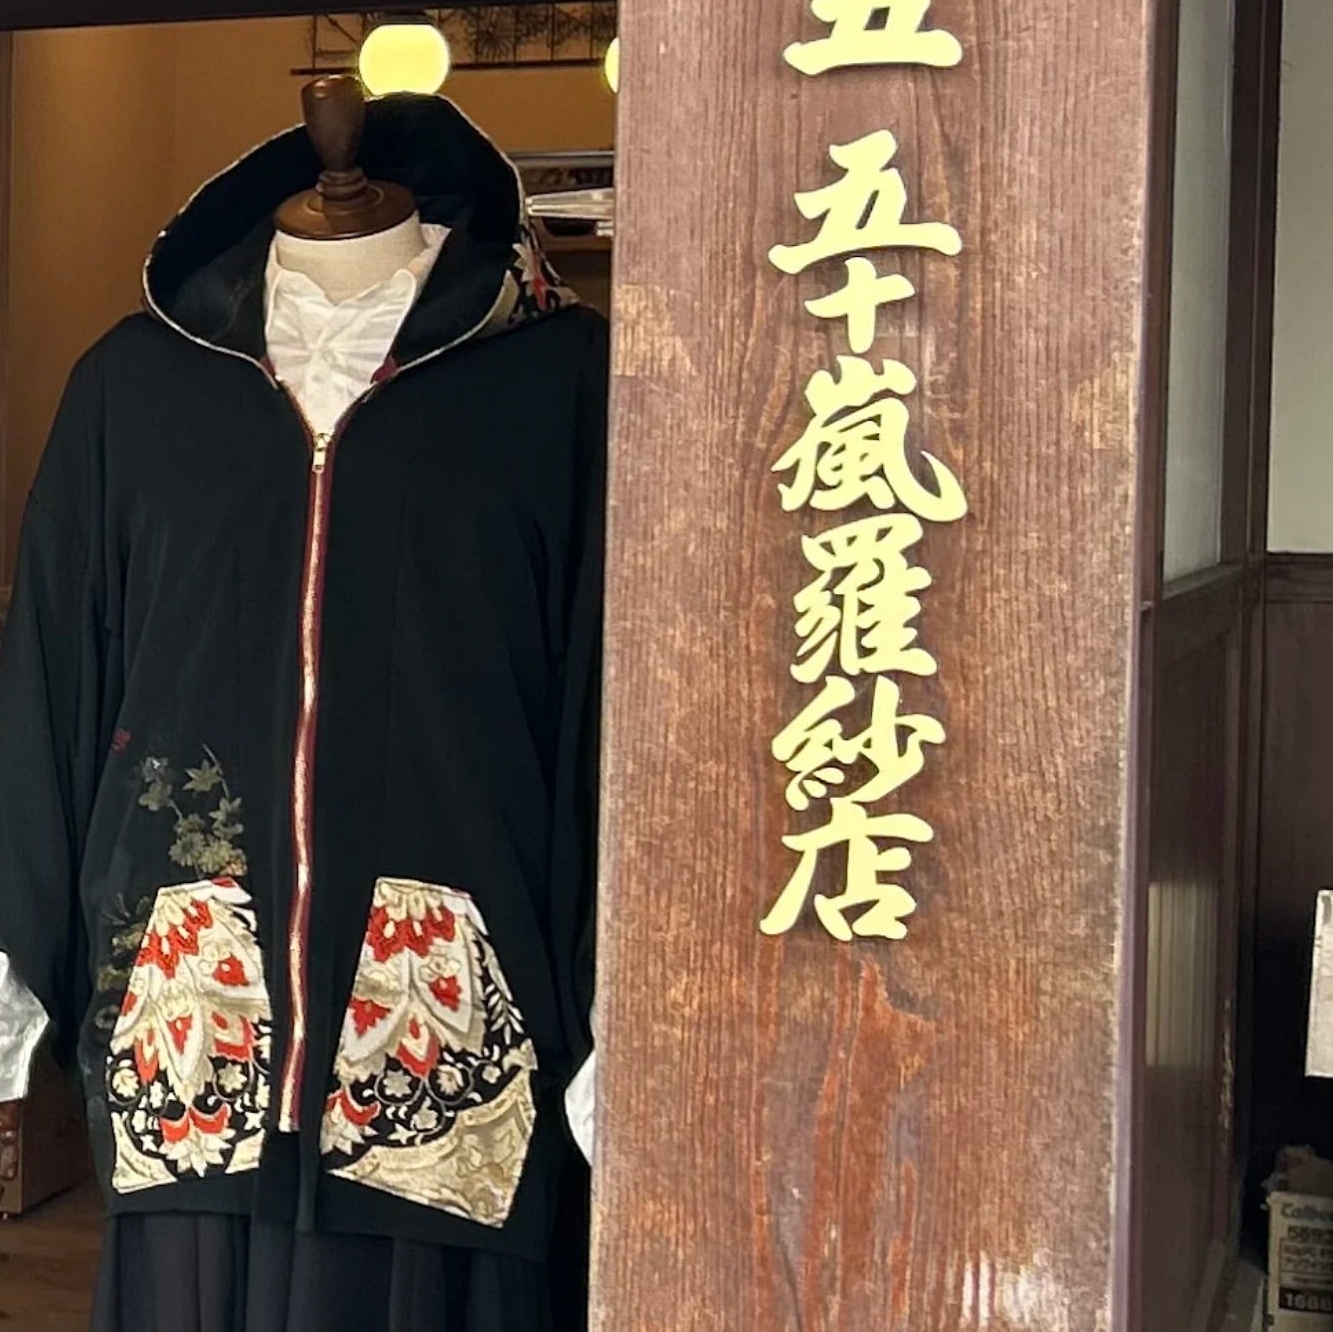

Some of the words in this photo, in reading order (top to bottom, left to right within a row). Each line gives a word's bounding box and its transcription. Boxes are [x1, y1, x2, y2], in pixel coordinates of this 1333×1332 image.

[758, 128, 969, 942] 五十嵐羅紗店
